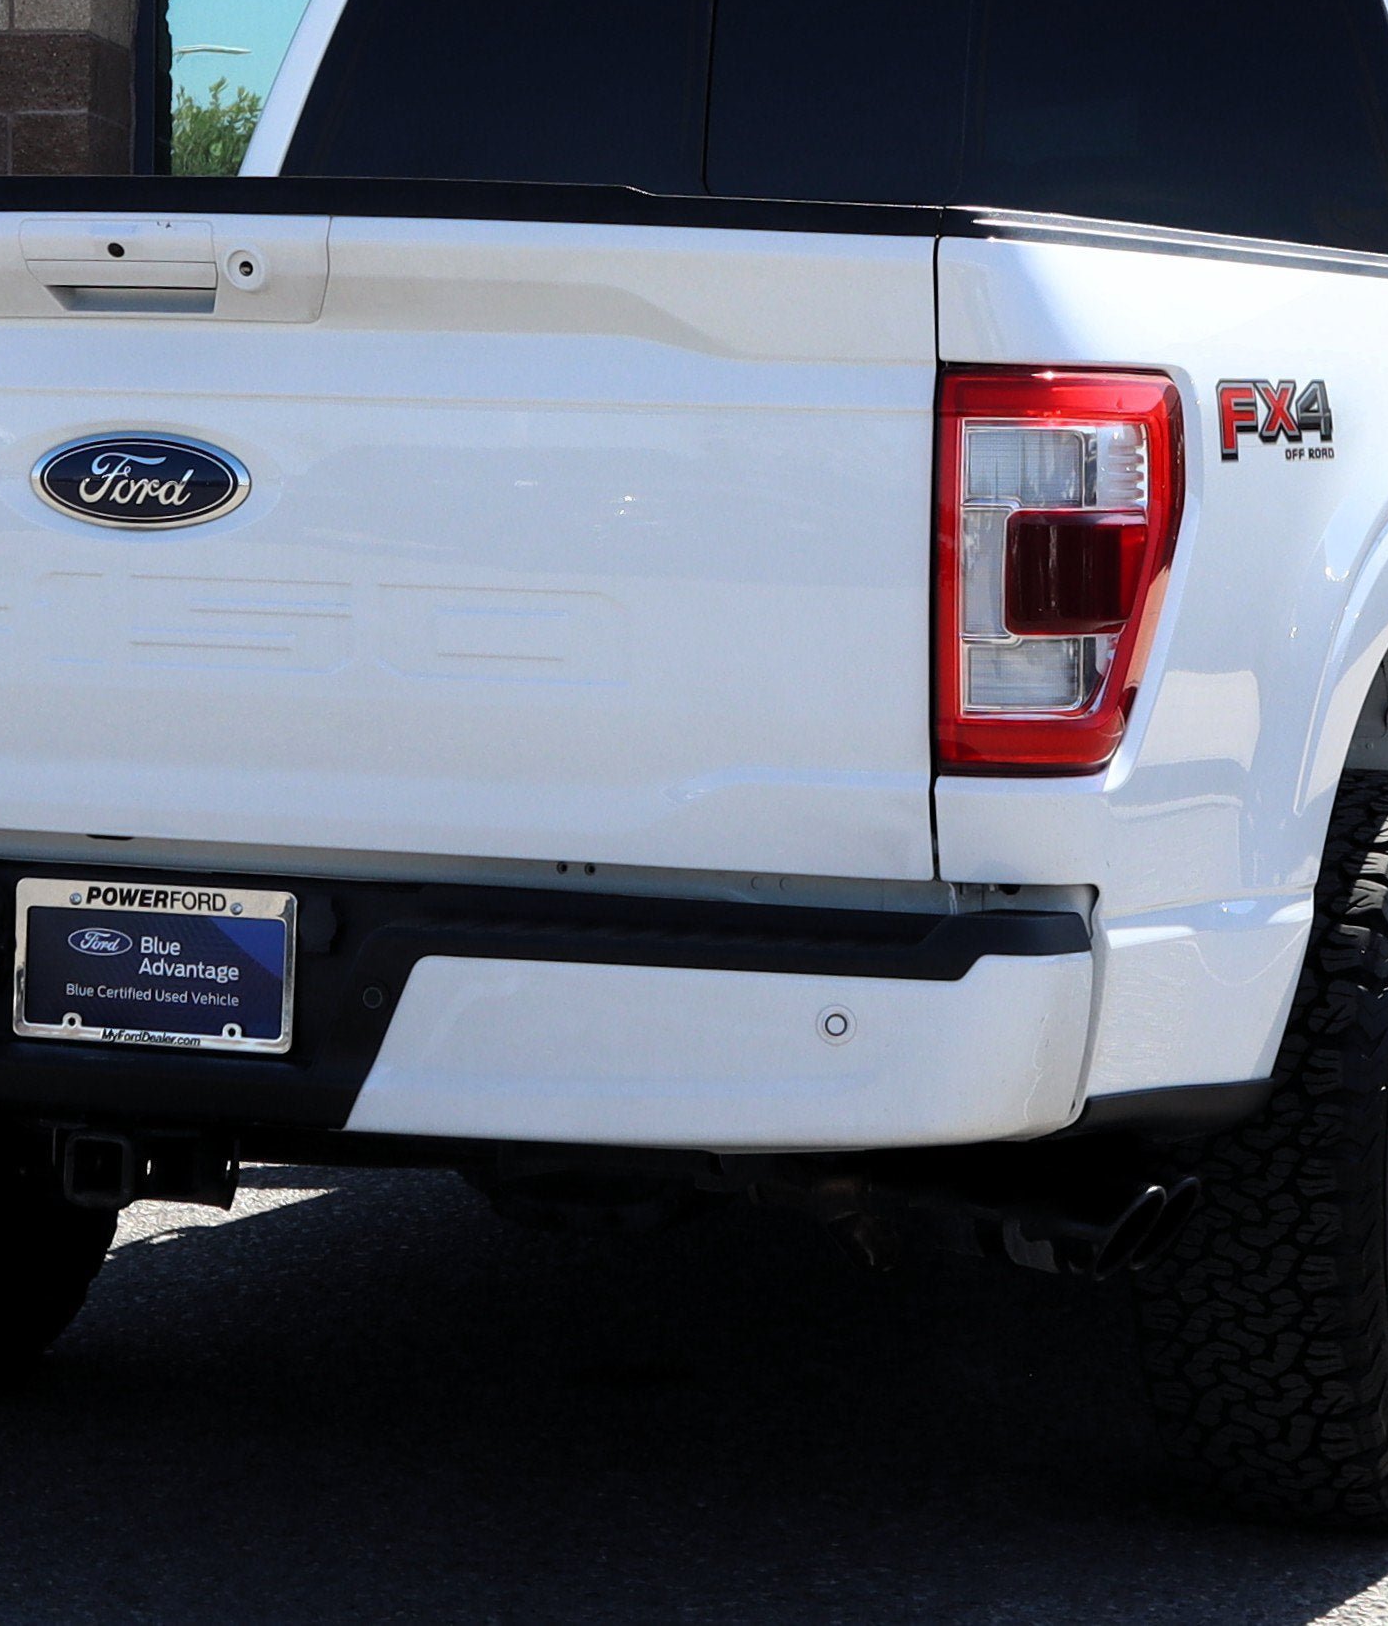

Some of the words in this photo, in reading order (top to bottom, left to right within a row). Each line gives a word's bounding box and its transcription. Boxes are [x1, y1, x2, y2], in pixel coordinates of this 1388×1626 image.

[1215, 378, 1333, 462] FX4
[1285, 448, 1305, 460] OFF
[1308, 447, 1334, 459] ROAD
[78, 451, 195, 506] Ford
[85, 886, 227, 912] POWERFORD
[79, 930, 121, 952] Ford
[140, 936, 181, 956] Blue
[138, 957, 240, 984] Advantage
[66, 983, 94, 997] Blue
[97, 985, 152, 1001] Certified
[154, 989, 188, 1003] Used
[191, 991, 240, 1007] Vehicle
[101, 1028, 201, 1047] MyFordDealer.com
